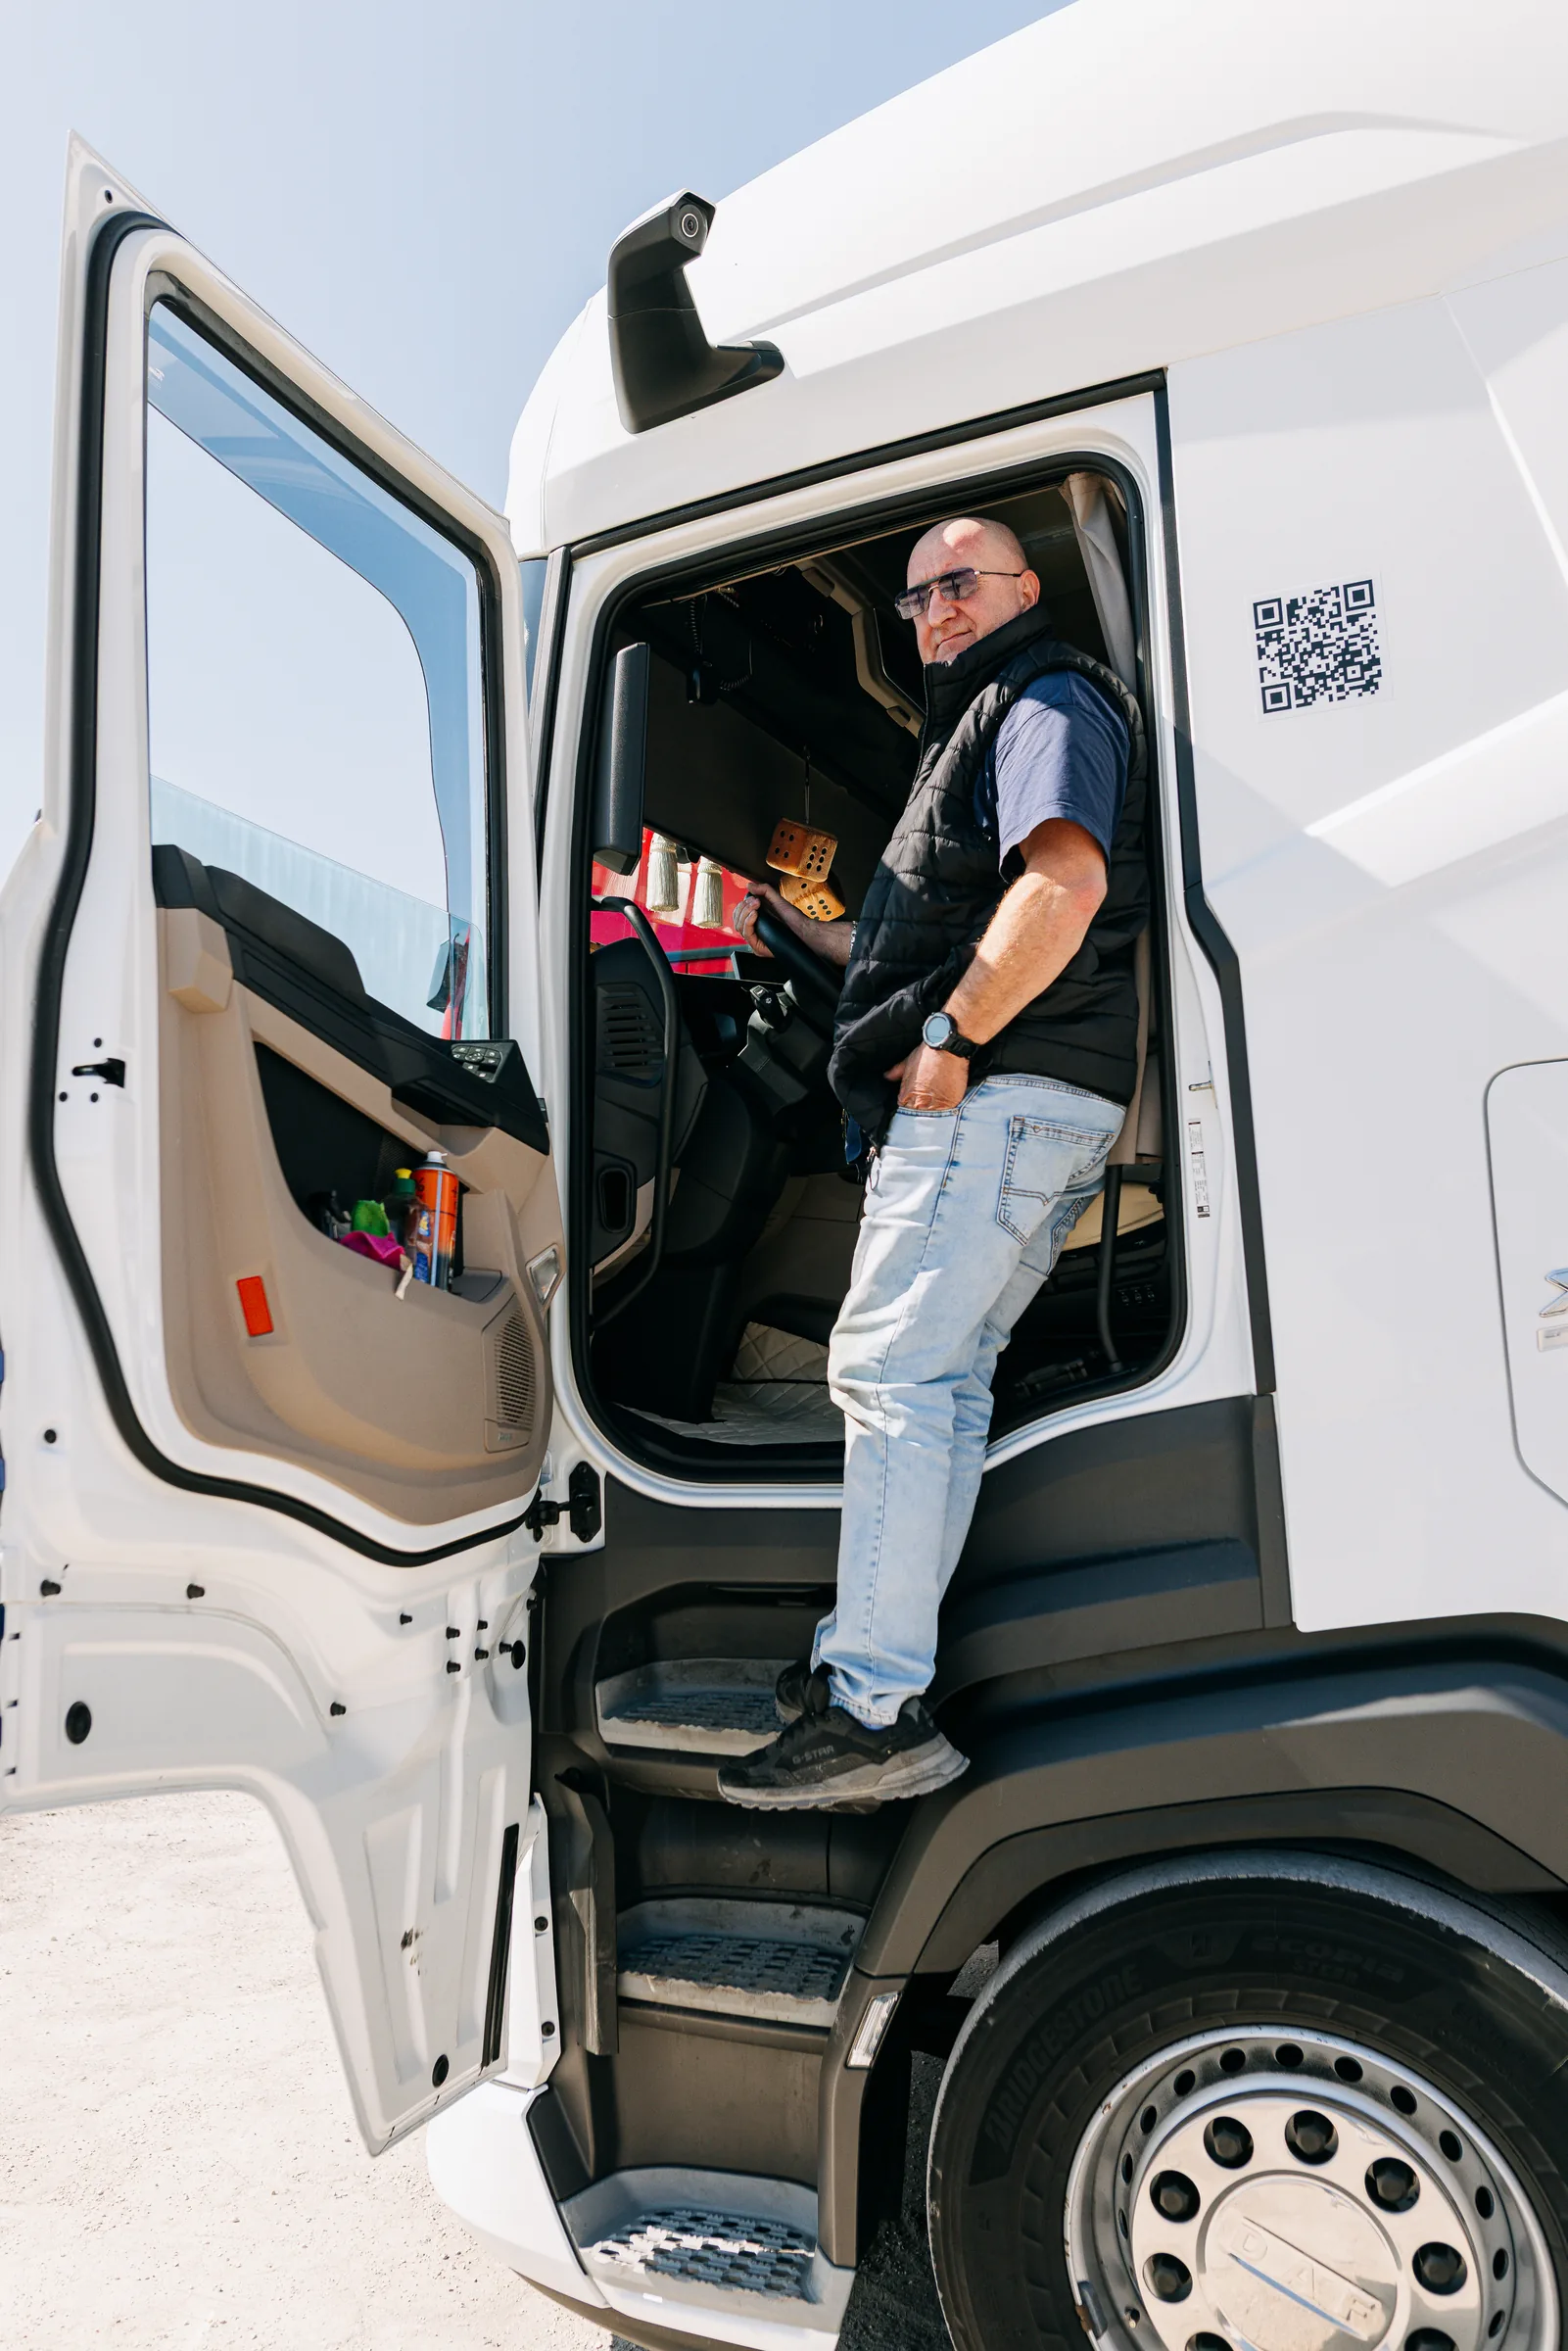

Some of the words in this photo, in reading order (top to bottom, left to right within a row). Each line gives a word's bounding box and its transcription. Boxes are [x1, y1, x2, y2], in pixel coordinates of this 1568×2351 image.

[791, 1746, 834, 1765] G-STAR
[983, 1962, 1143, 2150] BRIDGESTONE
[1231, 2225, 1376, 2321] DAF
